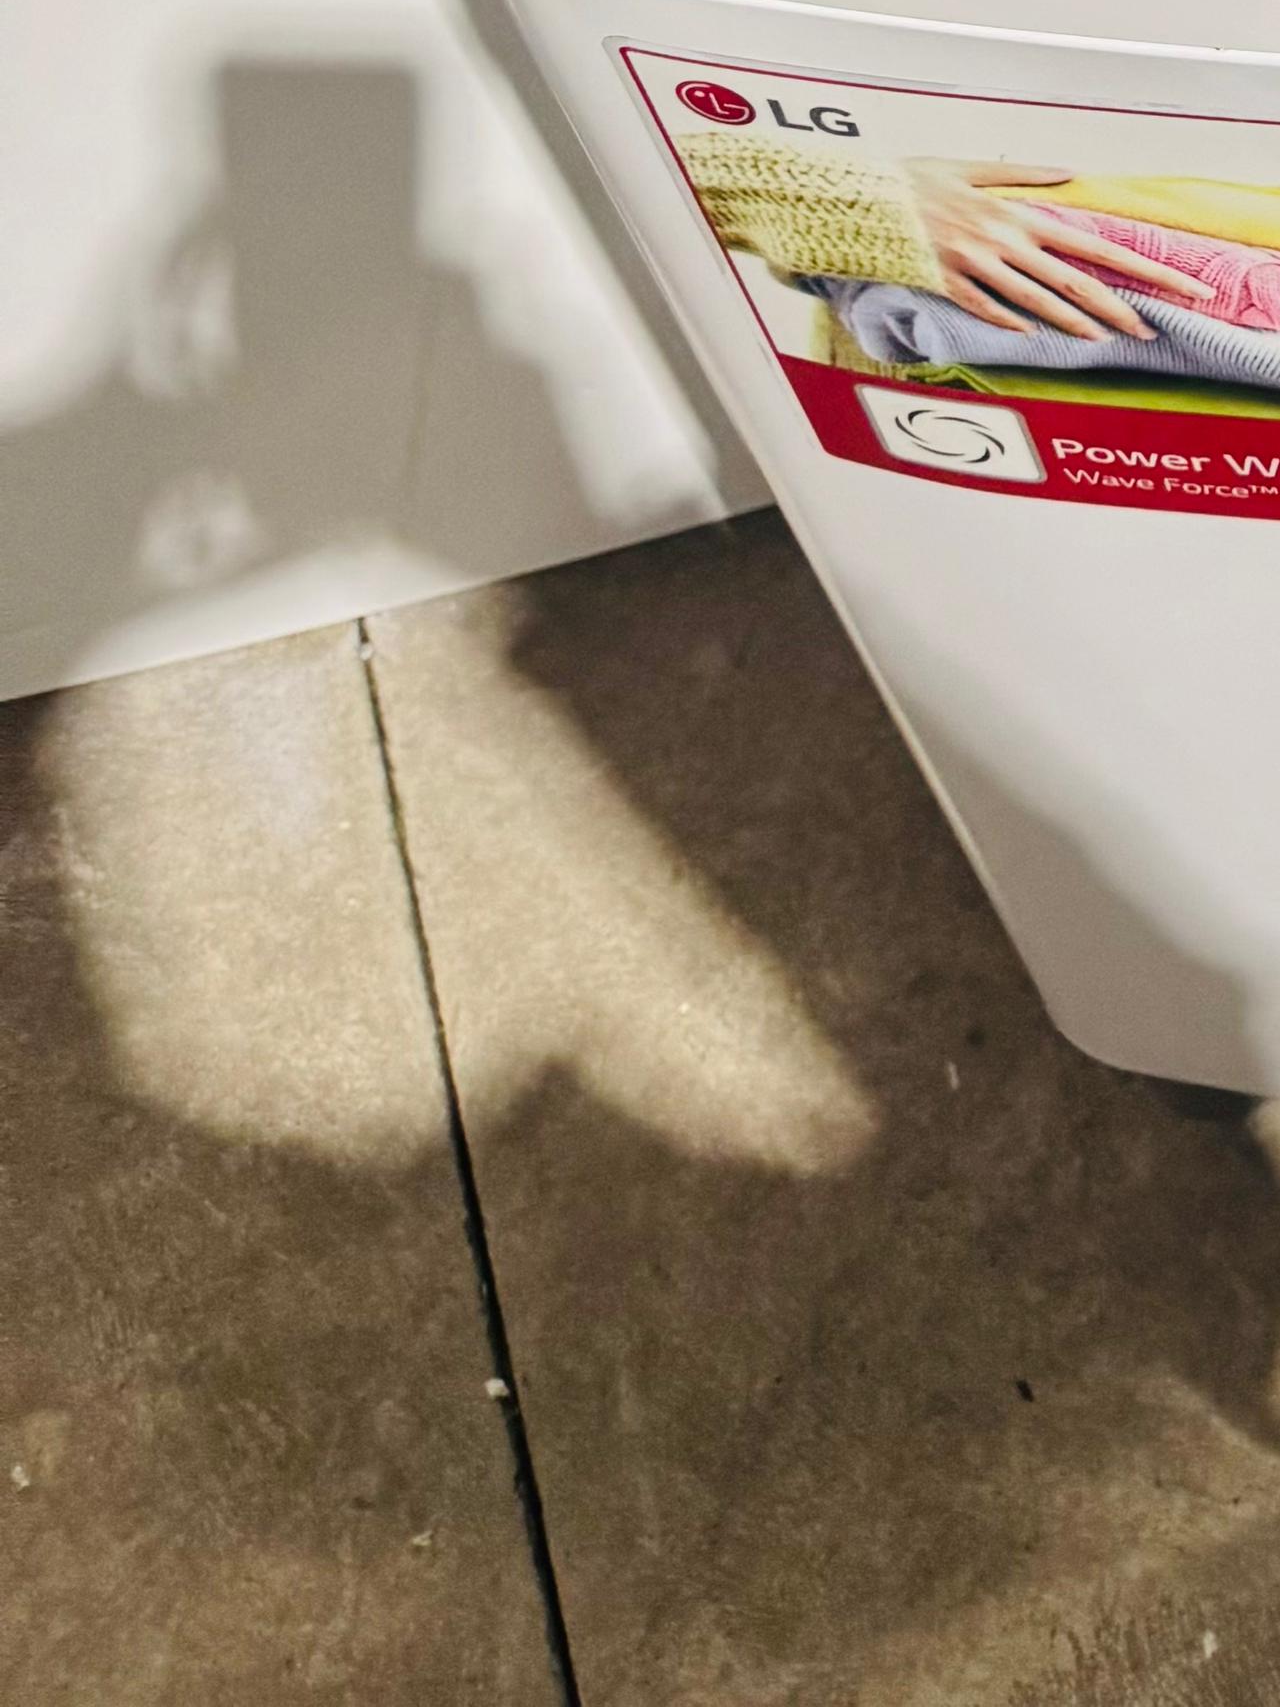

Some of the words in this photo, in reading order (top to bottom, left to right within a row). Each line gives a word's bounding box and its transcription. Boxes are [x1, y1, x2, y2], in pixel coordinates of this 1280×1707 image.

[766, 98, 860, 137] LG
[1051, 438, 1211, 472] Power
[1063, 467, 1155, 490] Wave
